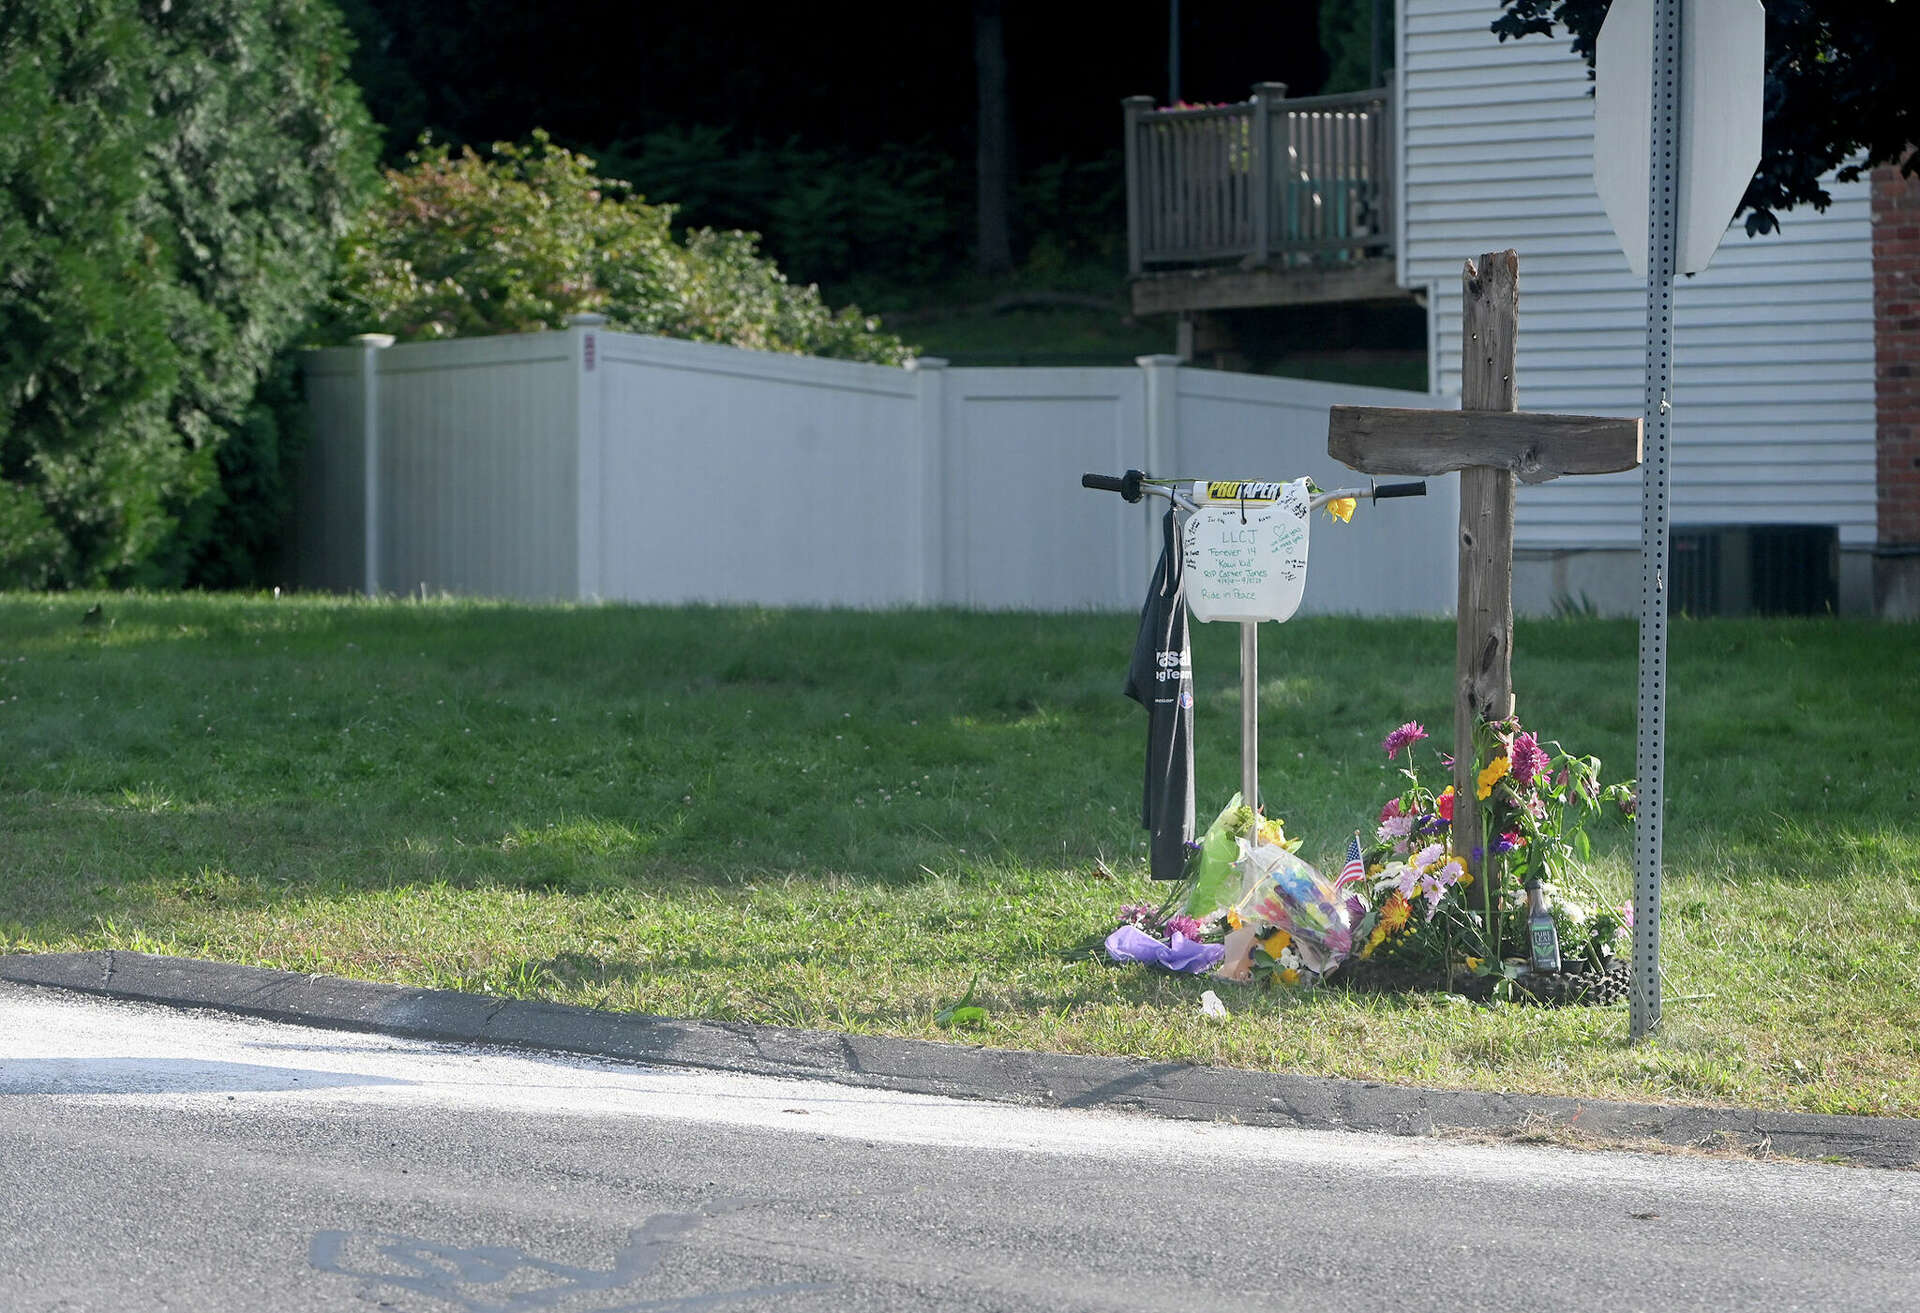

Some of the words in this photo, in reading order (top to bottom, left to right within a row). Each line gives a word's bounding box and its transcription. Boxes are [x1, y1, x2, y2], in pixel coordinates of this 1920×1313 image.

[1208, 547, 1241, 557] Forever
[1248, 546, 1257, 556] 14
[1201, 588, 1221, 600] Ride
[1232, 588, 1256, 600] Peace
